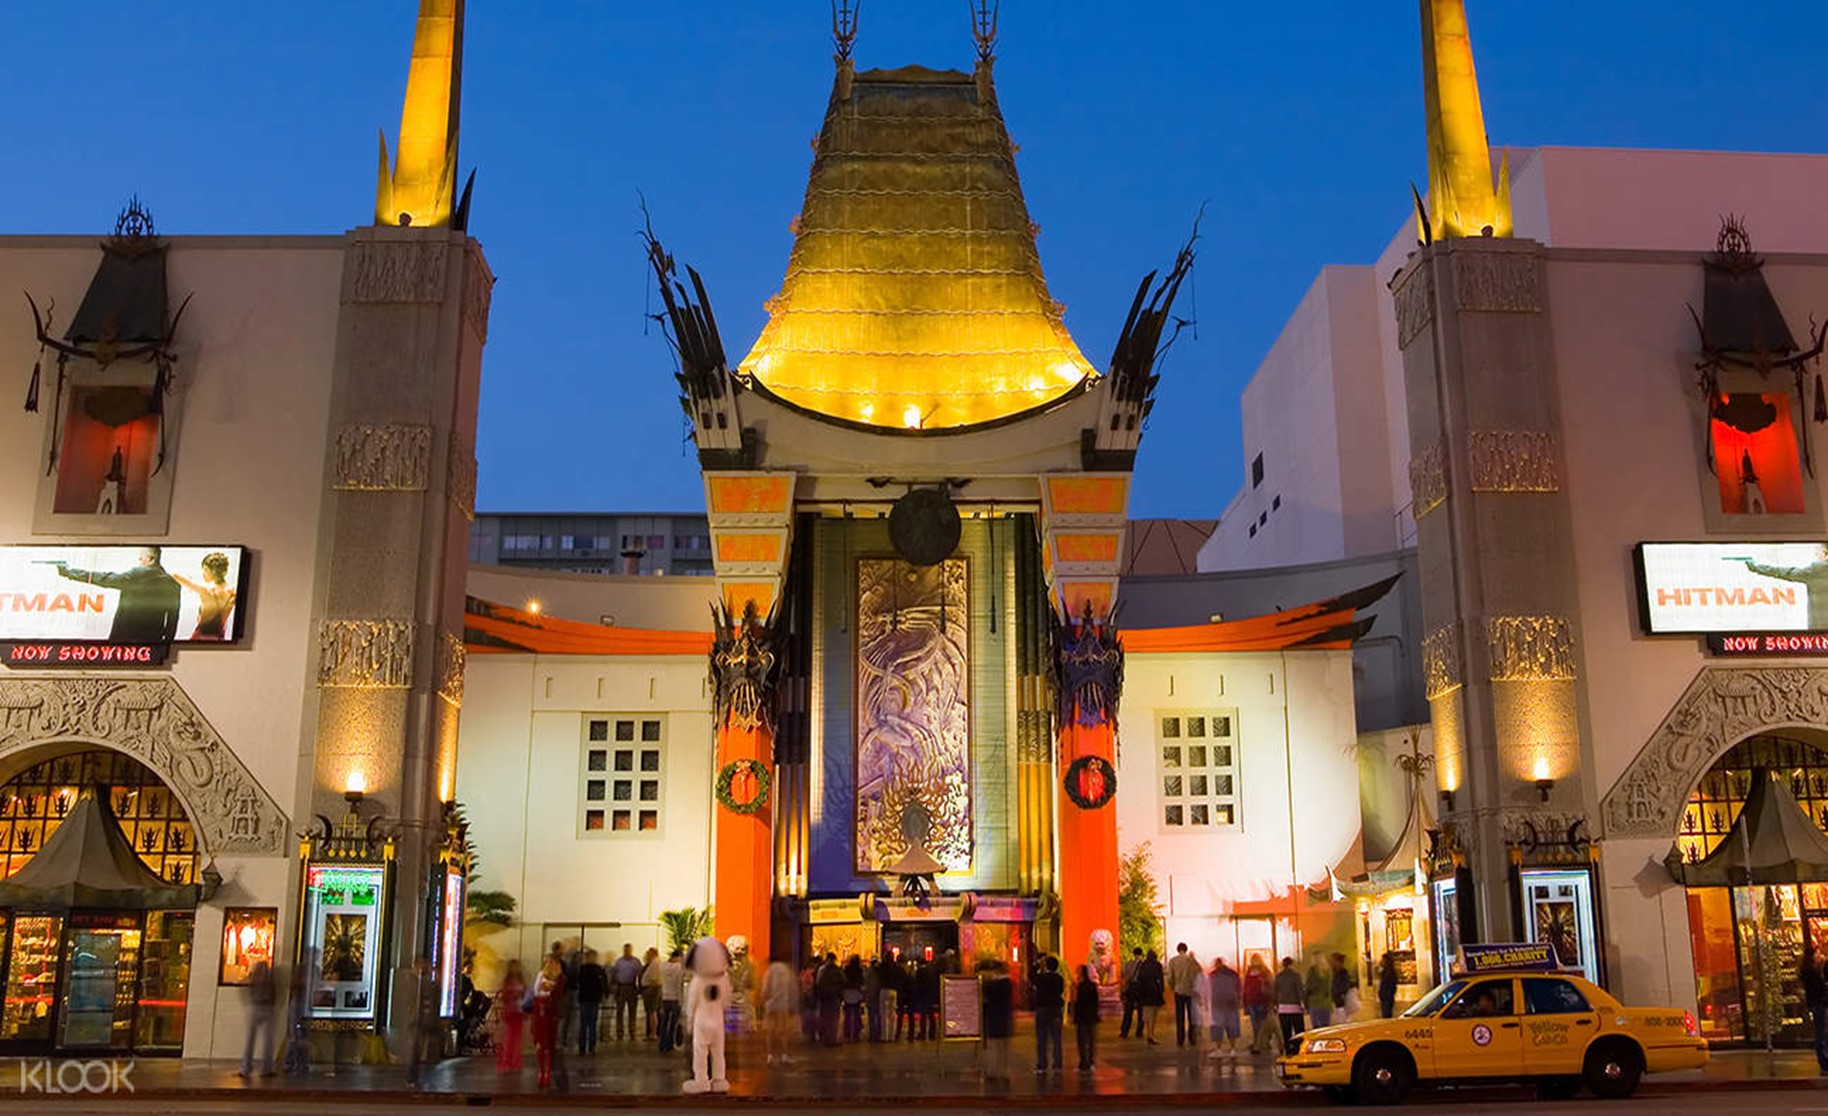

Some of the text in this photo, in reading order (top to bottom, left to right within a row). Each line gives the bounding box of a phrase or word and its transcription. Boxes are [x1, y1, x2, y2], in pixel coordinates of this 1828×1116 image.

[1657, 587, 1796, 606] HITMAN
[1722, 636, 1759, 652] NOW
[11, 646, 152, 661] NOW SHOWING
[1527, 1020, 1570, 1035] Yellow
